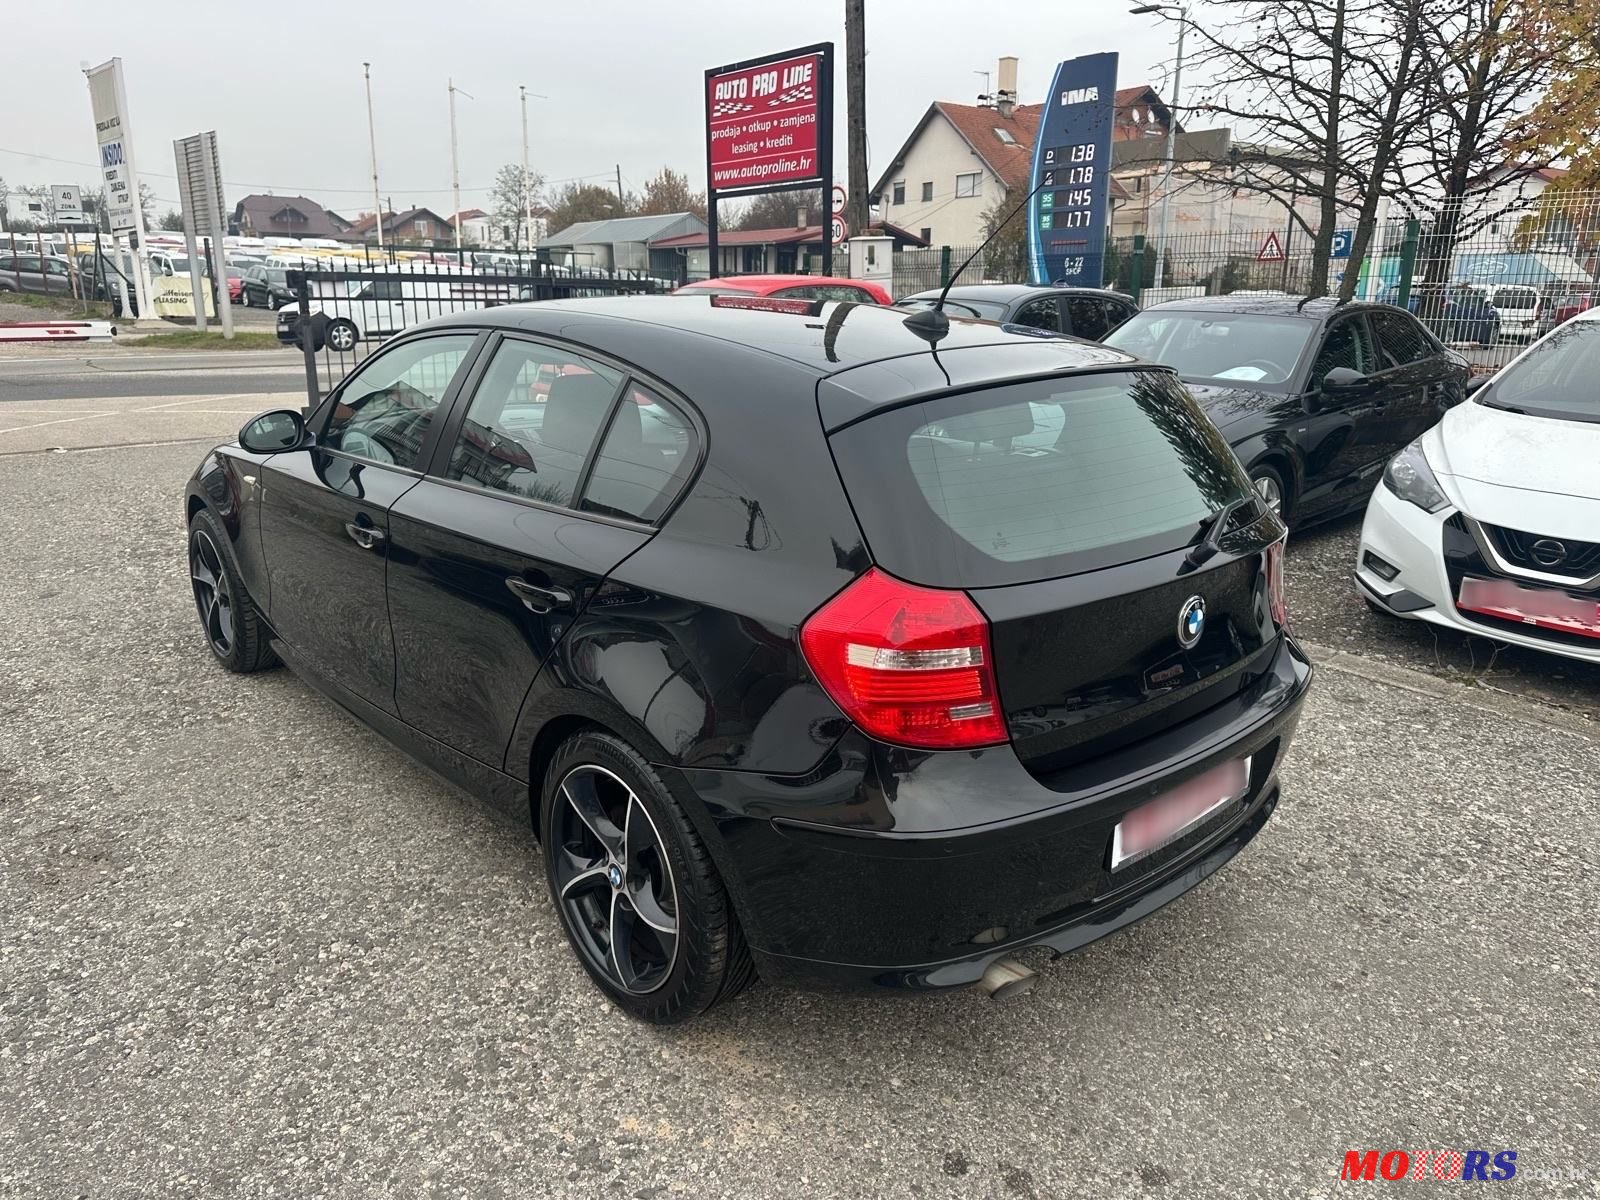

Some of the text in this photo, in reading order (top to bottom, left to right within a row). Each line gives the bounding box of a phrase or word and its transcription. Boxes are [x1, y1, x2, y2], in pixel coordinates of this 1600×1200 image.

[714, 63, 812, 100] AUTO PRO LINE
[711, 113, 816, 141] prodaja otkup zamjena
[732, 133, 793, 154] leasing krediti
[1046, 143, 1096, 162] D 1.38
[102, 142, 122, 168] INSIDO
[714, 155, 812, 181] www.autoproline.hr
[1069, 166, 1094, 185] 1.78
[61, 191, 72, 200] 40
[1042, 188, 1092, 206] 95 1.45
[1066, 210, 1092, 228] 1.77
[1330, 236, 1346, 257] P
[161, 289, 194, 297] aiffeisen
